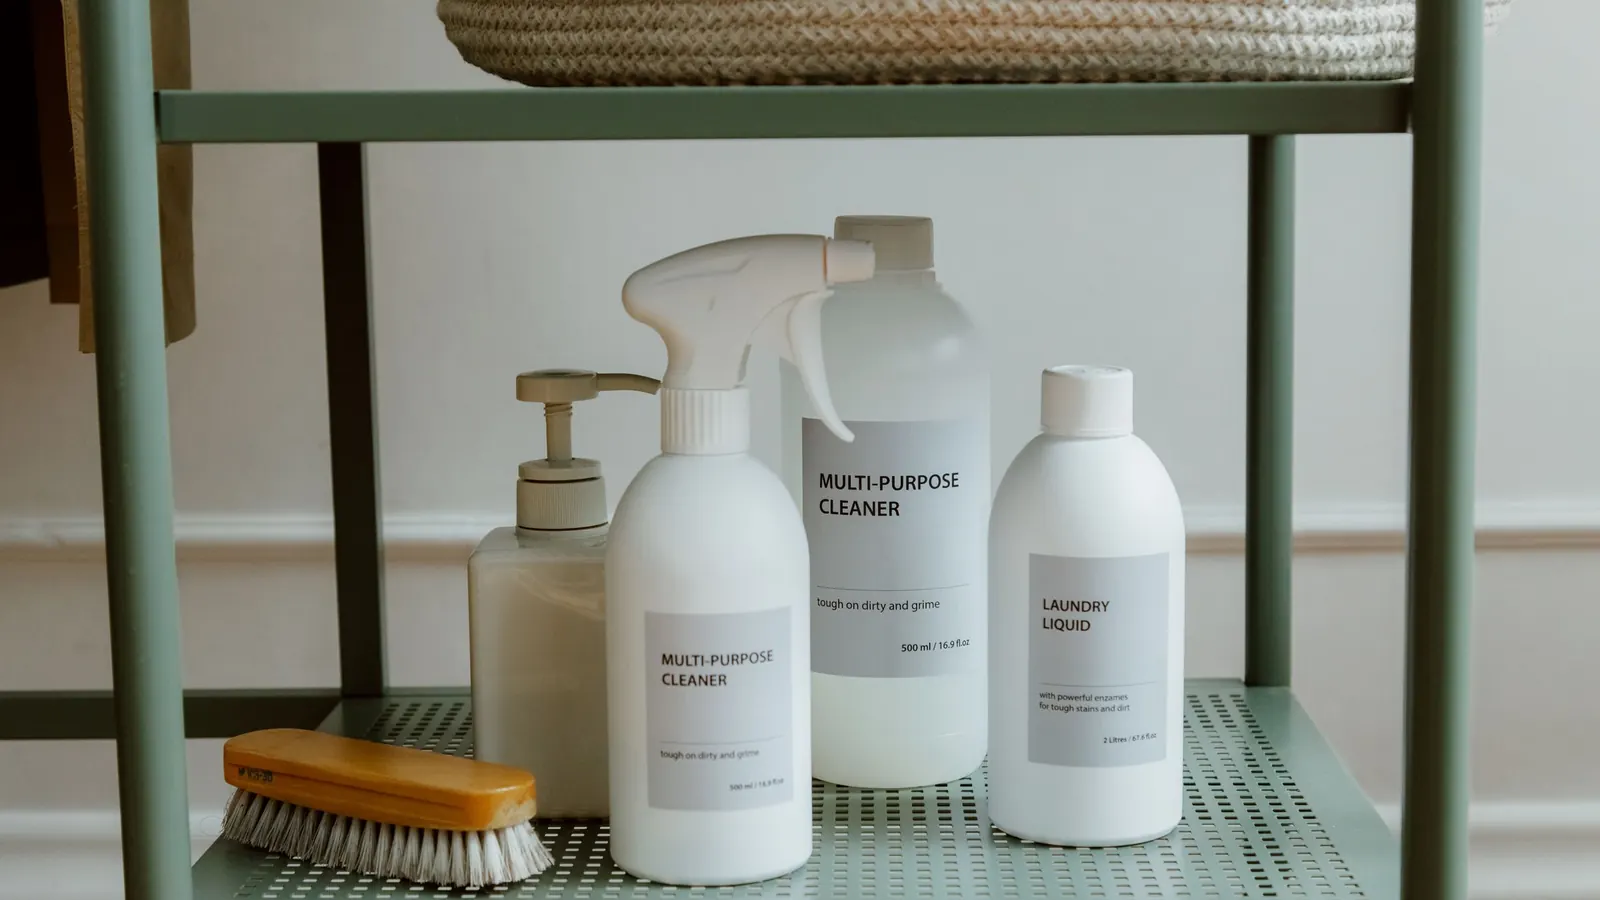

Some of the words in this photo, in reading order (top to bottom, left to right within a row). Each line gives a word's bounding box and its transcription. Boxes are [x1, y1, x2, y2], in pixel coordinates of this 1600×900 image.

[819, 472, 960, 491] MULTI-PURPOSE
[819, 498, 900, 517] CLEANER
[816, 598, 844, 611] tough
[846, 602, 859, 610] on
[861, 600, 887, 613] dirty
[888, 600, 909, 611] and
[911, 600, 940, 613] grime
[1042, 598, 1110, 613] LAUNDRY
[1042, 617, 1091, 632] LIQUID
[901, 643, 918, 652] 500
[920, 642, 932, 651] ml
[939, 640, 955, 650] 16.9
[661, 649, 775, 667] MULTI-PURPOSE
[661, 672, 728, 687] CLEANER
[1039, 692, 1056, 700] with
[1057, 693, 1093, 702] powerful
[1039, 701, 1050, 710] for
[1051, 703, 1075, 714] tough
[1076, 704, 1099, 713] stains
[1100, 704, 1116, 713] and
[1117, 704, 1131, 712] dirt
[1109, 735, 1127, 744] Litres
[660, 749, 684, 761] tough
[685, 752, 696, 760] on
[698, 750, 718, 761] dirty
[719, 750, 735, 760] and
